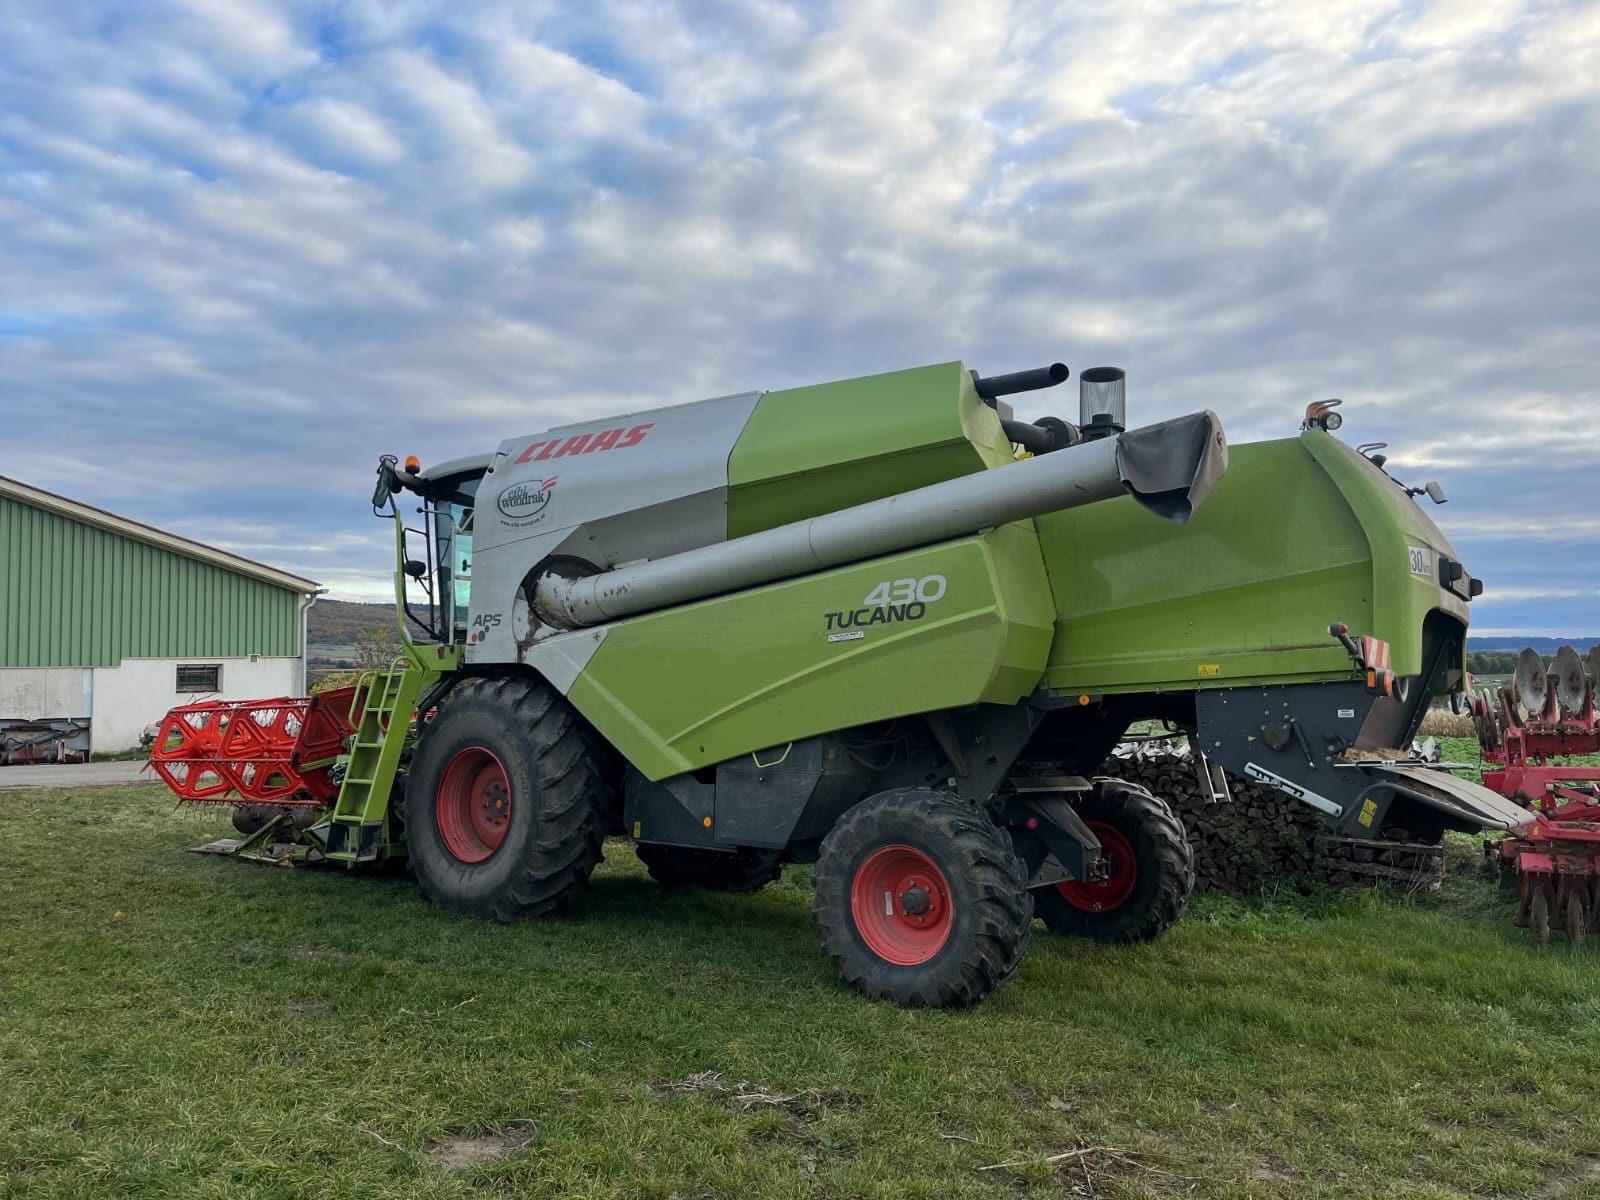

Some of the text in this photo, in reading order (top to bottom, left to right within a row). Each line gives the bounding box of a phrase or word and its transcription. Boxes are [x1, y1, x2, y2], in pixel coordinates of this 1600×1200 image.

[512, 422, 657, 464] CLAAS
[502, 490, 544, 508] wondrak
[1410, 550, 1423, 573] 30
[863, 574, 947, 607] 430
[472, 613, 503, 627] APS
[824, 601, 926, 630] TUCANO
